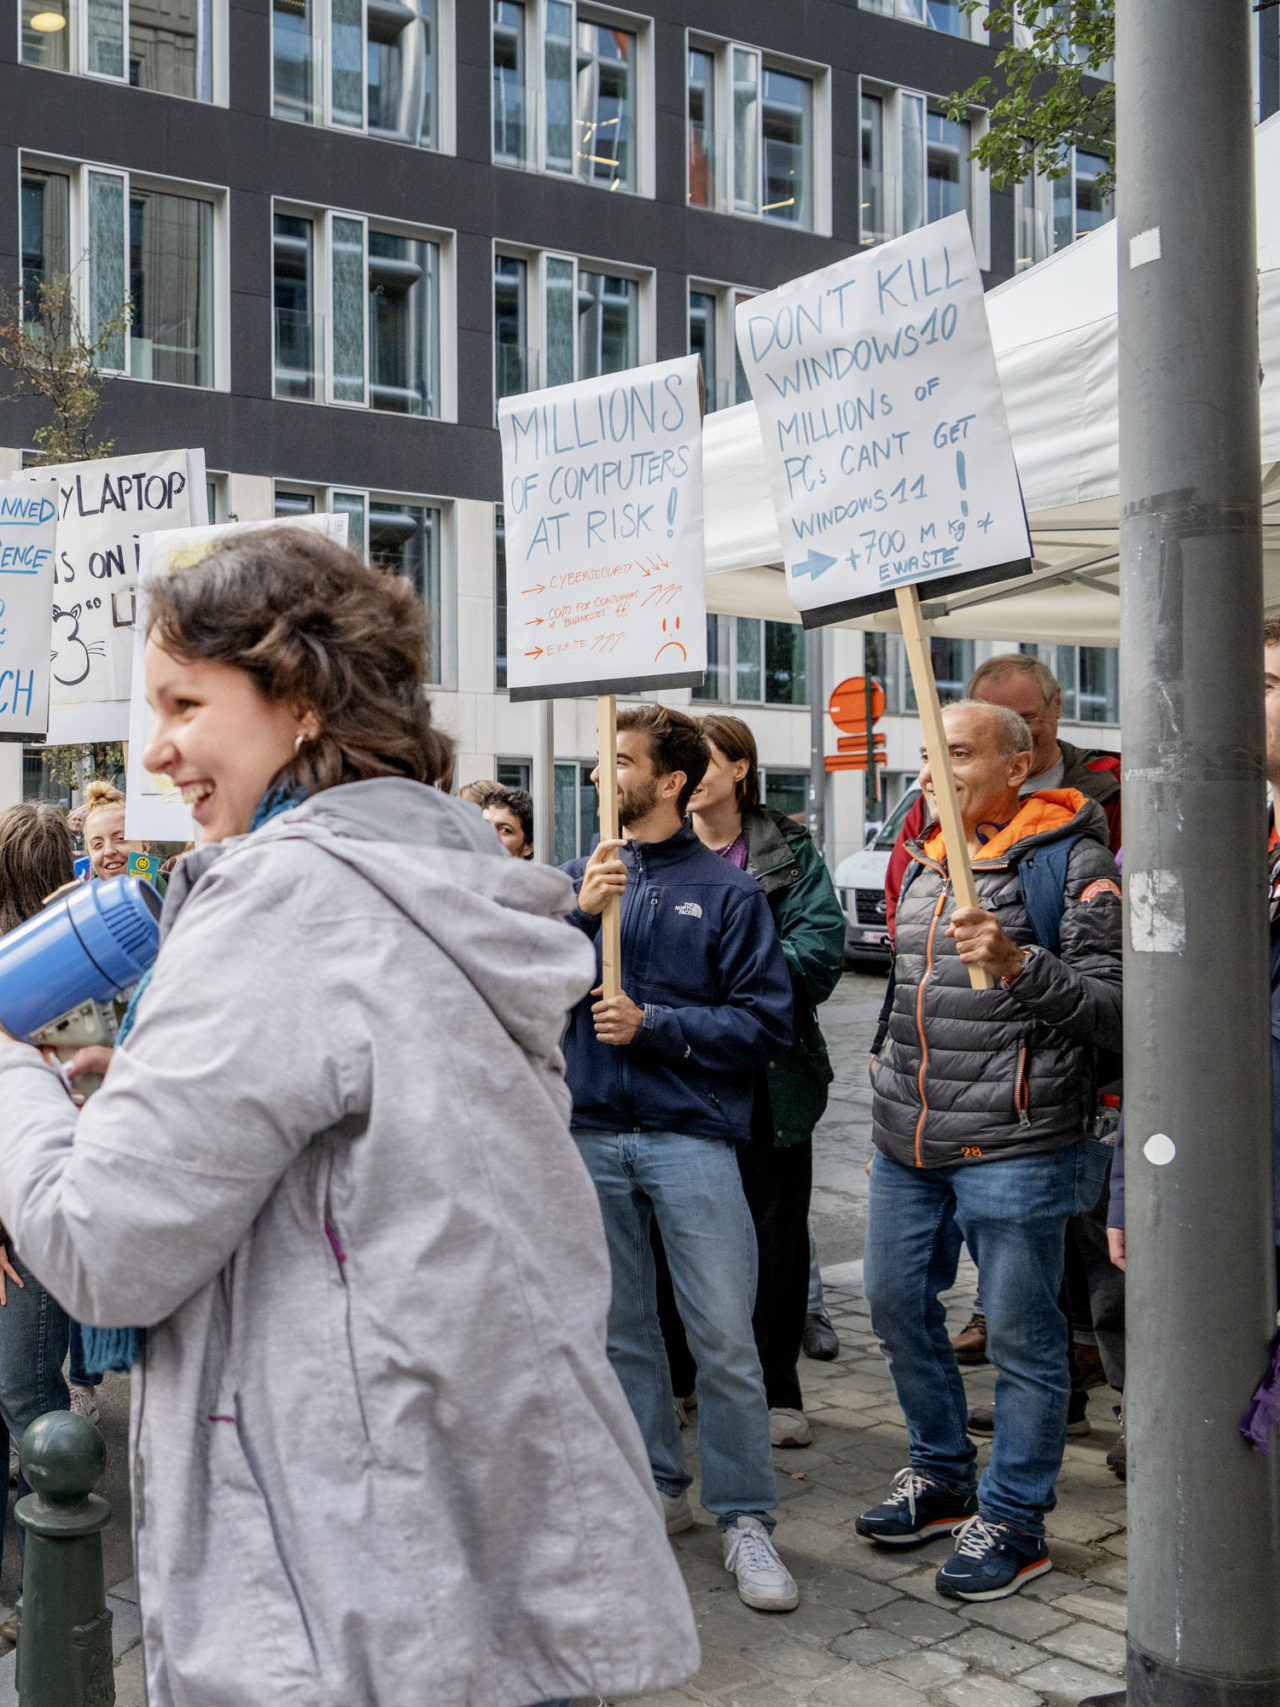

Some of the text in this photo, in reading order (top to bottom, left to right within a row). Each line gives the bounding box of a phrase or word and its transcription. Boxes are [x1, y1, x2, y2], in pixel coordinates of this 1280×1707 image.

[748, 246, 965, 364] DON'T KILL
[511, 374, 685, 465] MILLIONS
[777, 377, 940, 452] MILLIONS OF
[933, 414, 976, 449] GET
[76, 471, 186, 517] LAPTOP
[510, 445, 690, 514] OF COMPUTERS
[526, 512, 571, 561] AT
[89, 544, 125, 579] ON
[960, 1146, 983, 1157] 28
